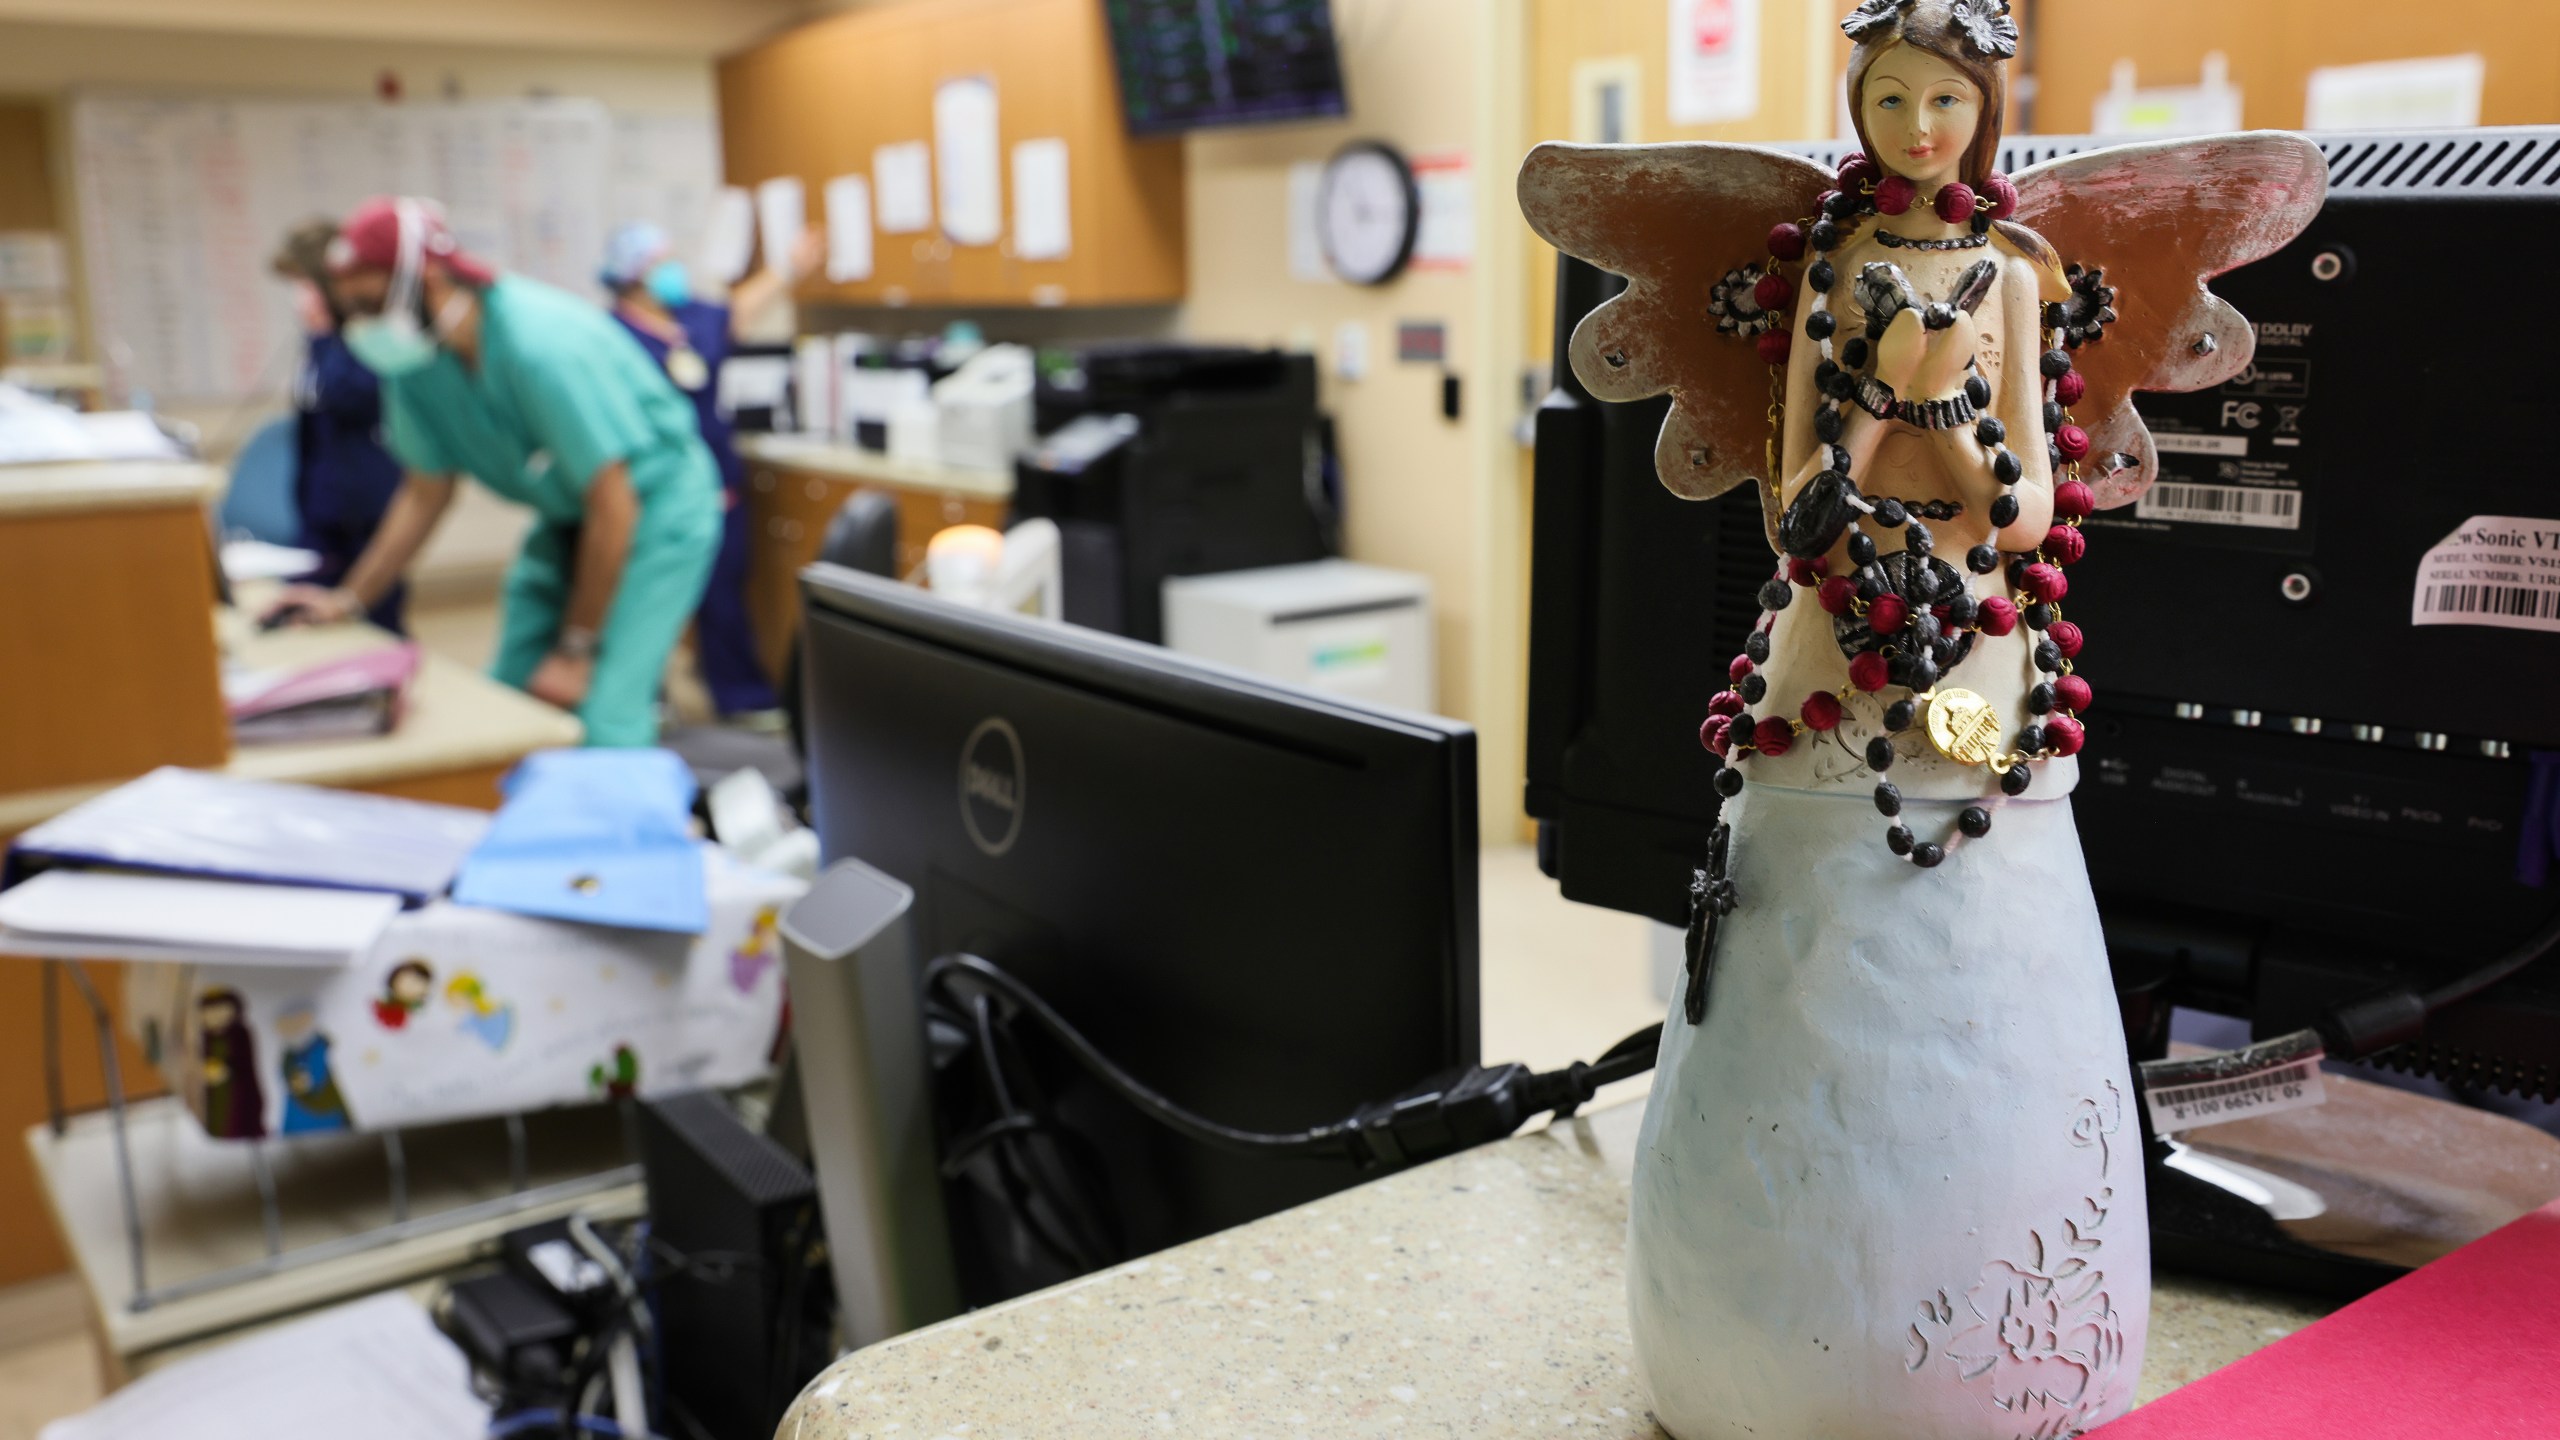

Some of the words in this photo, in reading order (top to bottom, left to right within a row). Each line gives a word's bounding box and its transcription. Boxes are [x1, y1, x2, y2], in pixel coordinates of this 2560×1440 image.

[2261, 322, 2313, 337] DOLBY
[2433, 553, 2467, 564] MODEL
[2429, 569, 2464, 581] SERIAL
